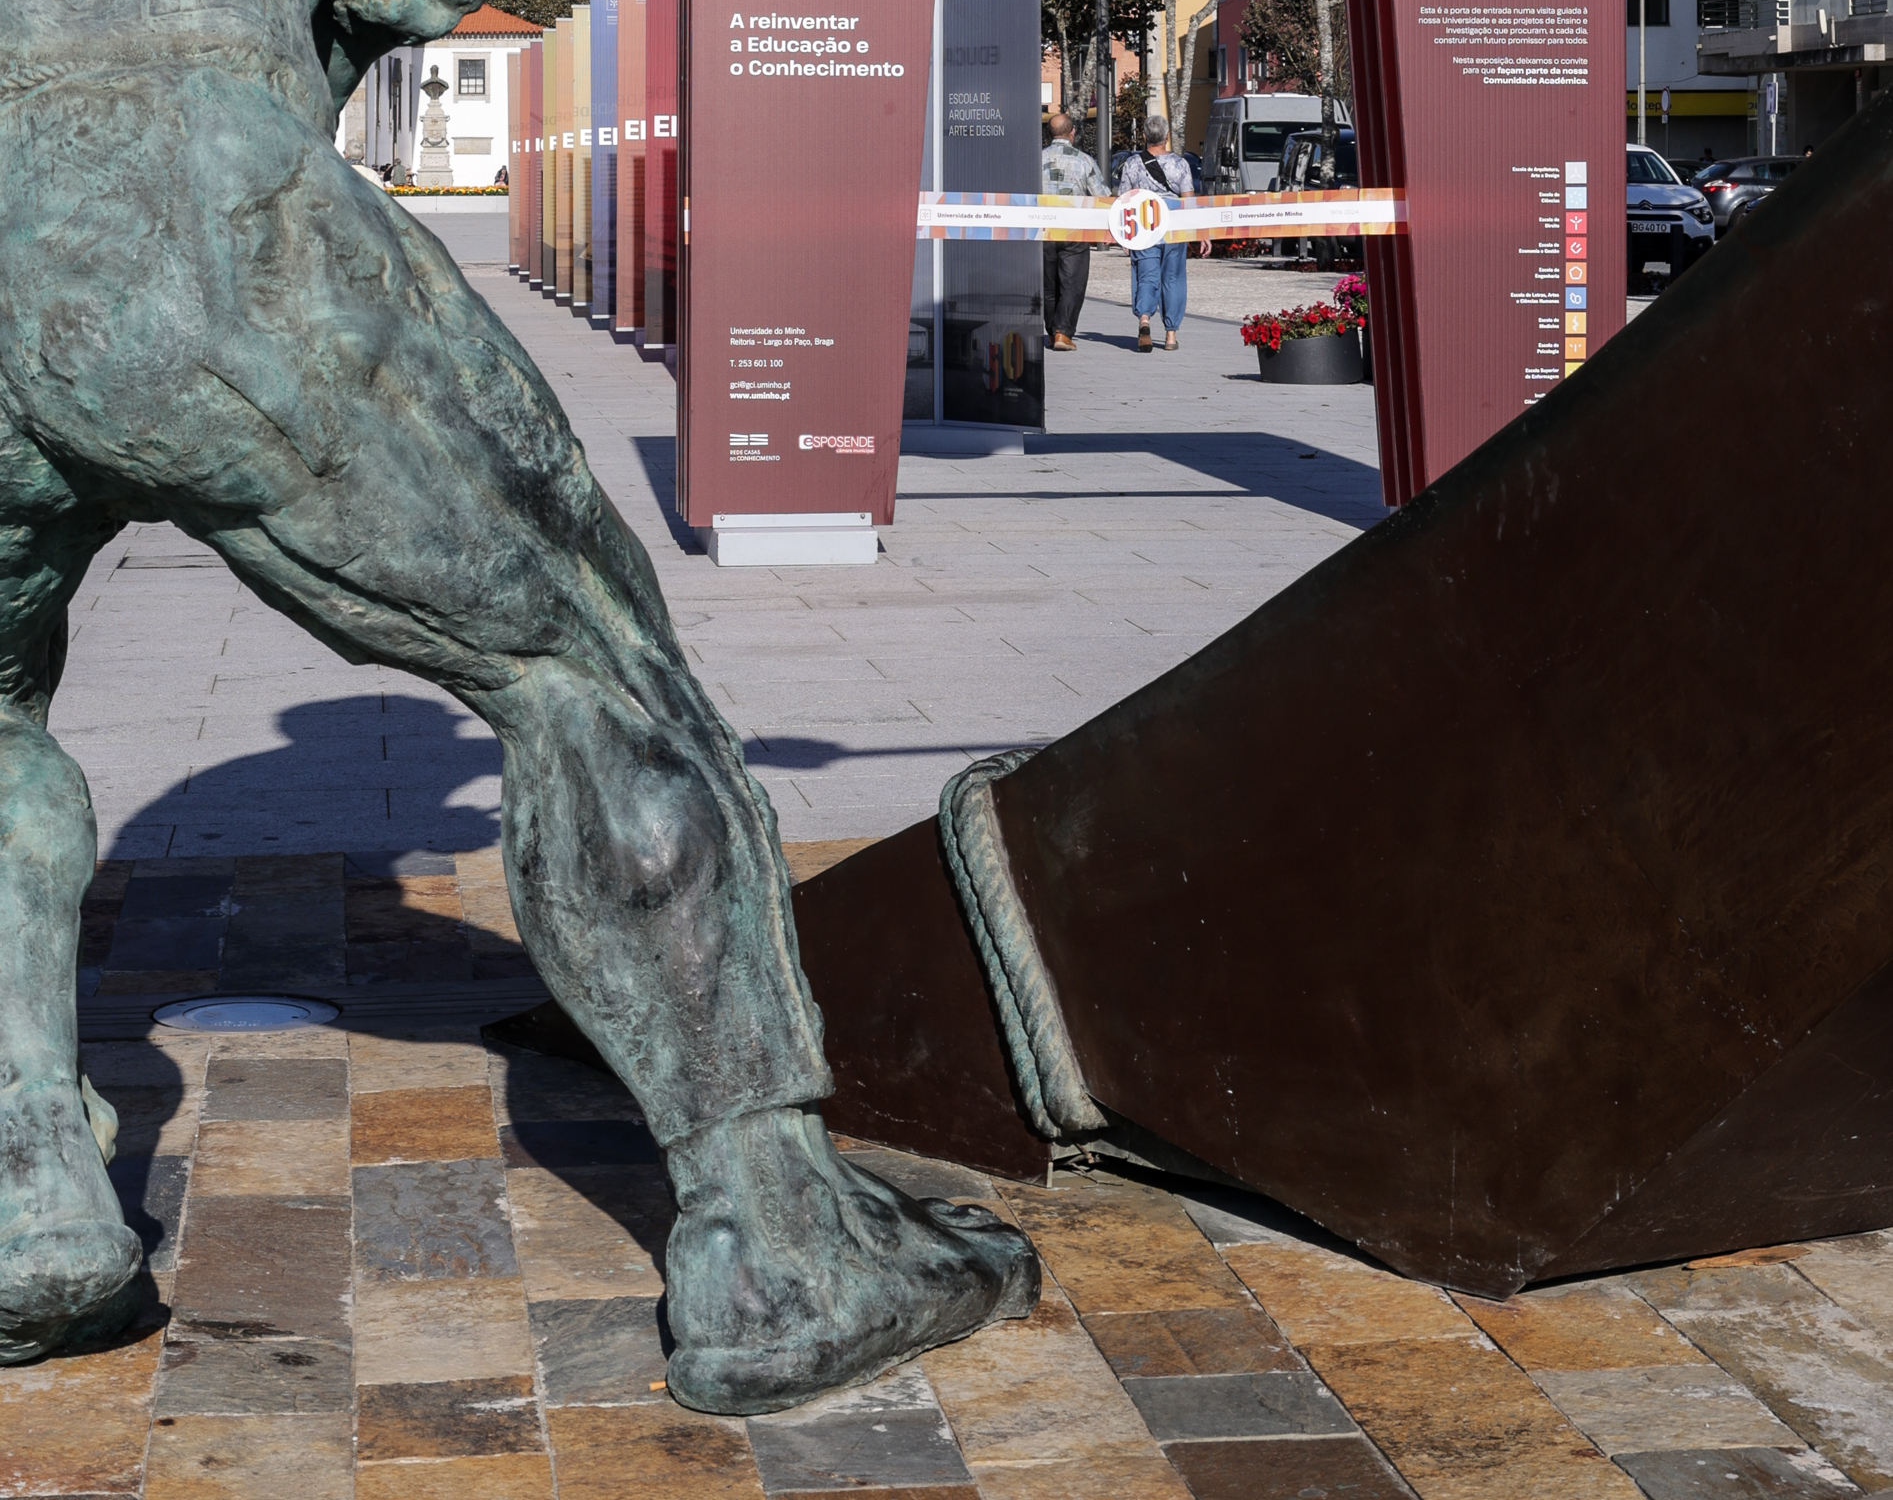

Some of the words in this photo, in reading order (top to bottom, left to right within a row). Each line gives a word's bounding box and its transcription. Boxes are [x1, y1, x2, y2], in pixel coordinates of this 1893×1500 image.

[1420, 6, 1436, 14] Esta
[1437, 6, 1442, 14] é
[1557, 7, 1582, 16] guiada
[730, 13, 744, 28] A
[750, 12, 859, 30] reinventar
[1513, 17, 1544, 26] projetos
[1557, 16, 1581, 24] Ensino
[1446, 27, 1492, 36] Investigação
[1510, 27, 1548, 35] procuram,
[1469, 36, 1482, 44] um
[1484, 36, 1506, 44] futuro
[1508, 37, 1546, 45] promissor
[1547, 37, 1564, 45] para
[730, 40, 742, 52] a
[748, 36, 850, 56] Educação
[856, 41, 869, 53] e
[1453, 56, 1474, 64] Nesta
[1476, 57, 1514, 66] exposição,
[1560, 57, 1588, 65] convite
[730, 63, 743, 75] o
[749, 60, 904, 77] Conhecimento
[1497, 66, 1524, 76] façam
[1526, 68, 1548, 76] parte
[949, 93, 978, 104] ESCOLA
[980, 92, 990, 104] DE
[949, 108, 1002, 121] ARQUITETURA,
[949, 125, 967, 136] ARTE
[970, 125, 974, 136] E
[976, 125, 1004, 136] DESIGN
[1119, 198, 1161, 241] 50
[730, 327, 772, 335] Universidade
[774, 327, 783, 335] do
[785, 327, 805, 335] Minho
[730, 338, 755, 346] Reitoria
[764, 338, 782, 347] Largo
[784, 338, 792, 346] do
[794, 338, 812, 346] Paço,
[815, 338, 834, 346] Braga
[738, 359, 752, 367] 253
[754, 359, 766, 367] 601
[770, 359, 783, 367] 100
[730, 381, 791, 390] gci@gci.uminho.pt
[730, 392, 790, 401] www.uminho.pt
